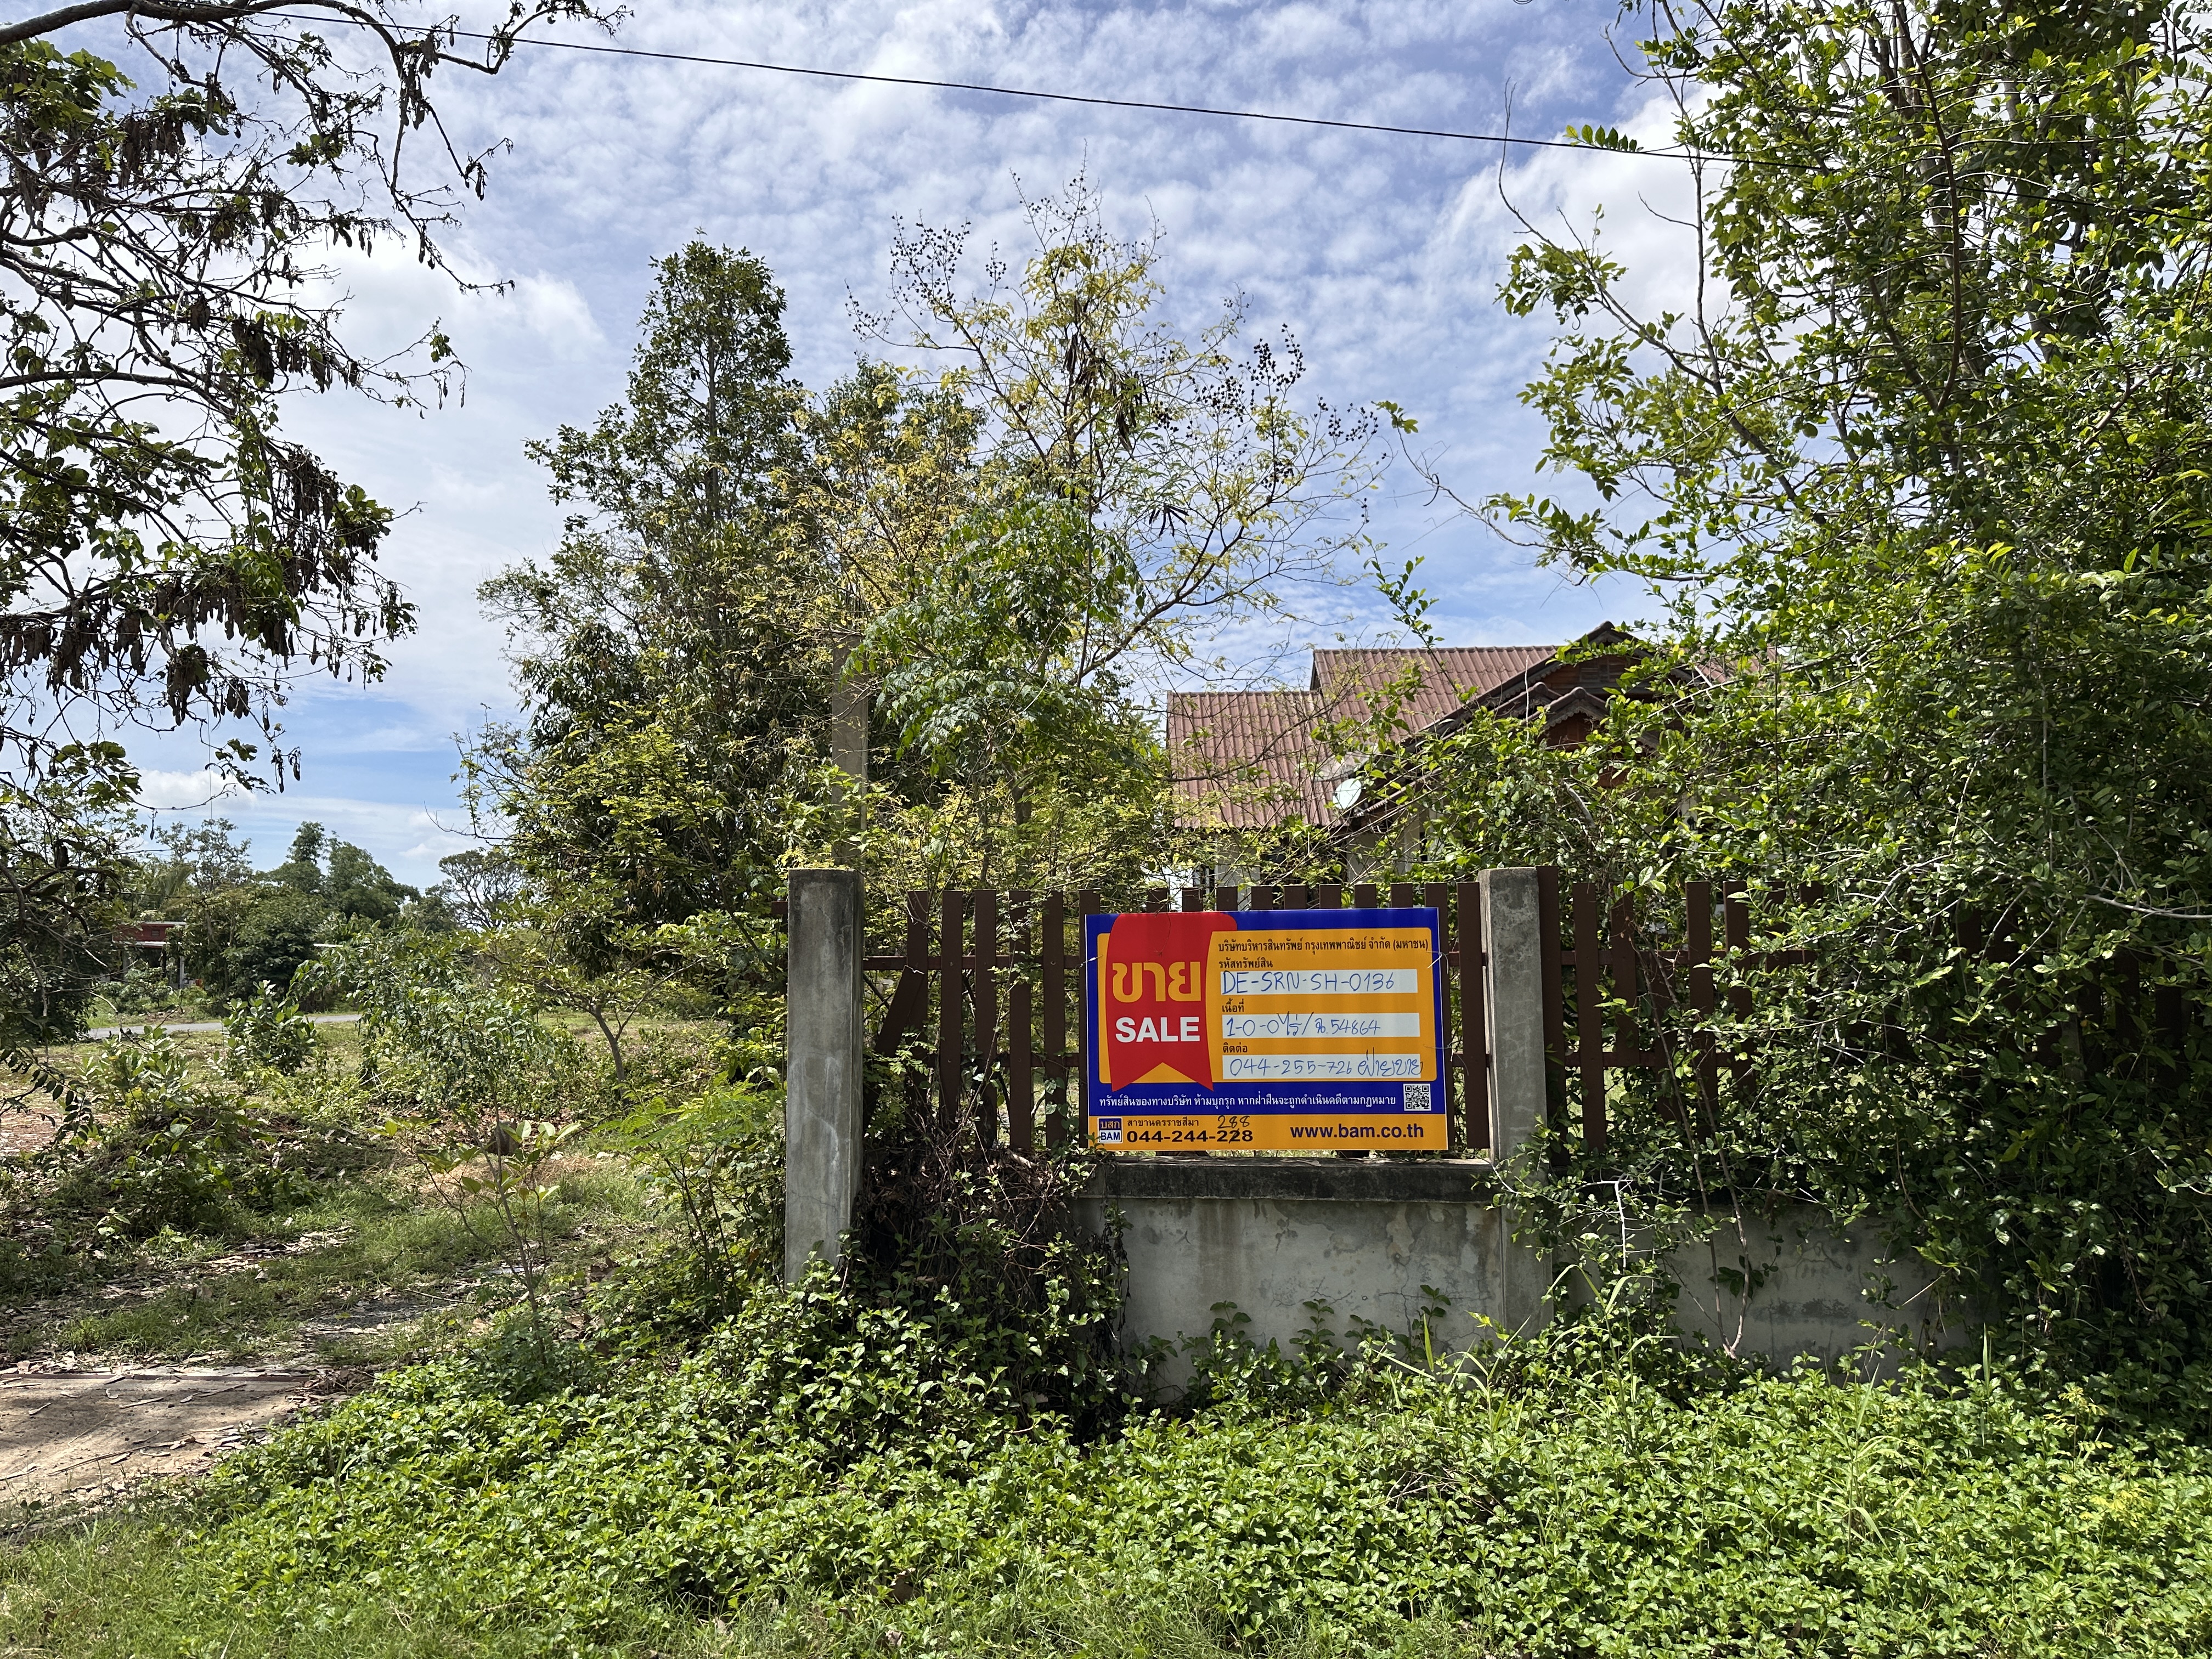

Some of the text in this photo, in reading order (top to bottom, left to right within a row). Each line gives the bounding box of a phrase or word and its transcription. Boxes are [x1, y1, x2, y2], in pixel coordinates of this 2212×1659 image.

[1218, 936, 1429, 955] บริษัทบริหารสินทรัพย์ กรุงเทพพาณิชย์ จำกัด (มหาชน)
[1218, 957, 1273, 968] รหัสทรัพย์สิน
[1113, 961, 1201, 1002] ขาย
[1222, 998, 1244, 1012] เนื้อที่
[1115, 1017, 1200, 1043] SALE
[1222, 1042, 1248, 1053] ติดต่อ
[1099, 1093, 1192, 1107] ทรัพย์สินของทางบริษัท
[1194, 1093, 1235, 1109] ห้ามบุกรุก
[1100, 1119, 1120, 1130] บสก
[1127, 1116, 1199, 1127] สาขานครราชสีมา
[1101, 1132, 1120, 1141] BAM
[1127, 1130, 1253, 1143] 044-244-228
[1290, 1124, 1424, 1138] www.bam.co.th
